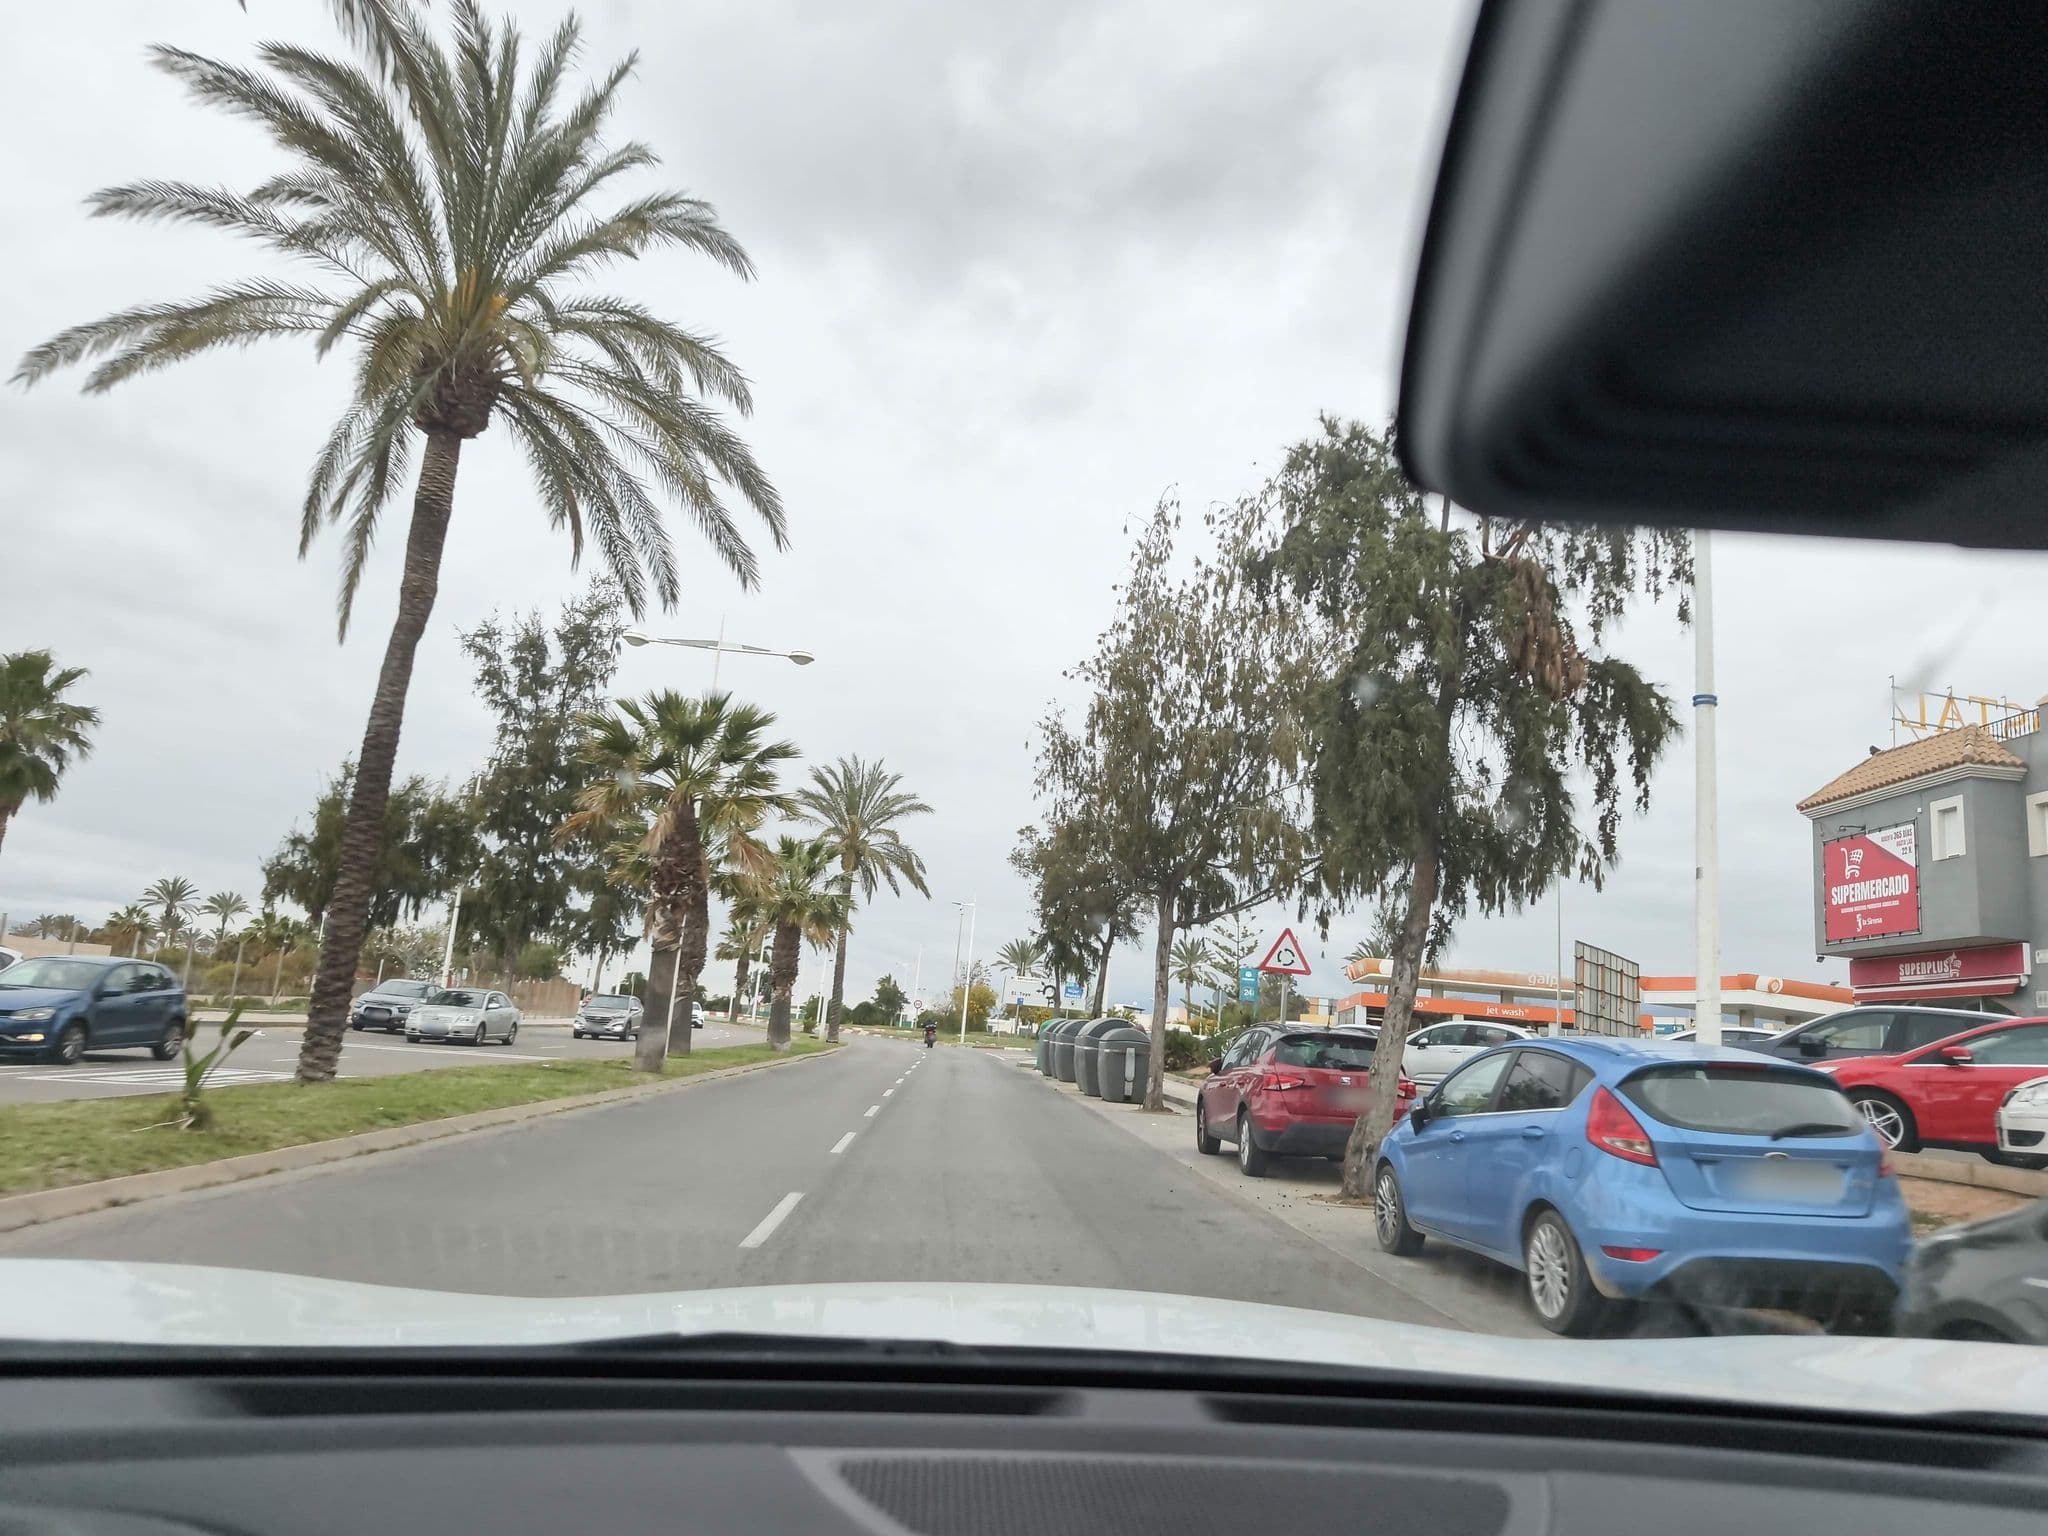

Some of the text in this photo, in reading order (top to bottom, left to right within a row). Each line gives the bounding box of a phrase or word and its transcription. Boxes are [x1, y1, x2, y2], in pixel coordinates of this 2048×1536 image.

[1831, 873, 1909, 906] SUPERMERCADO
[1899, 960, 1950, 976] SUPERPLUS
[1528, 974, 1558, 987] galp
[1486, 1005, 1525, 1017] jet wash
